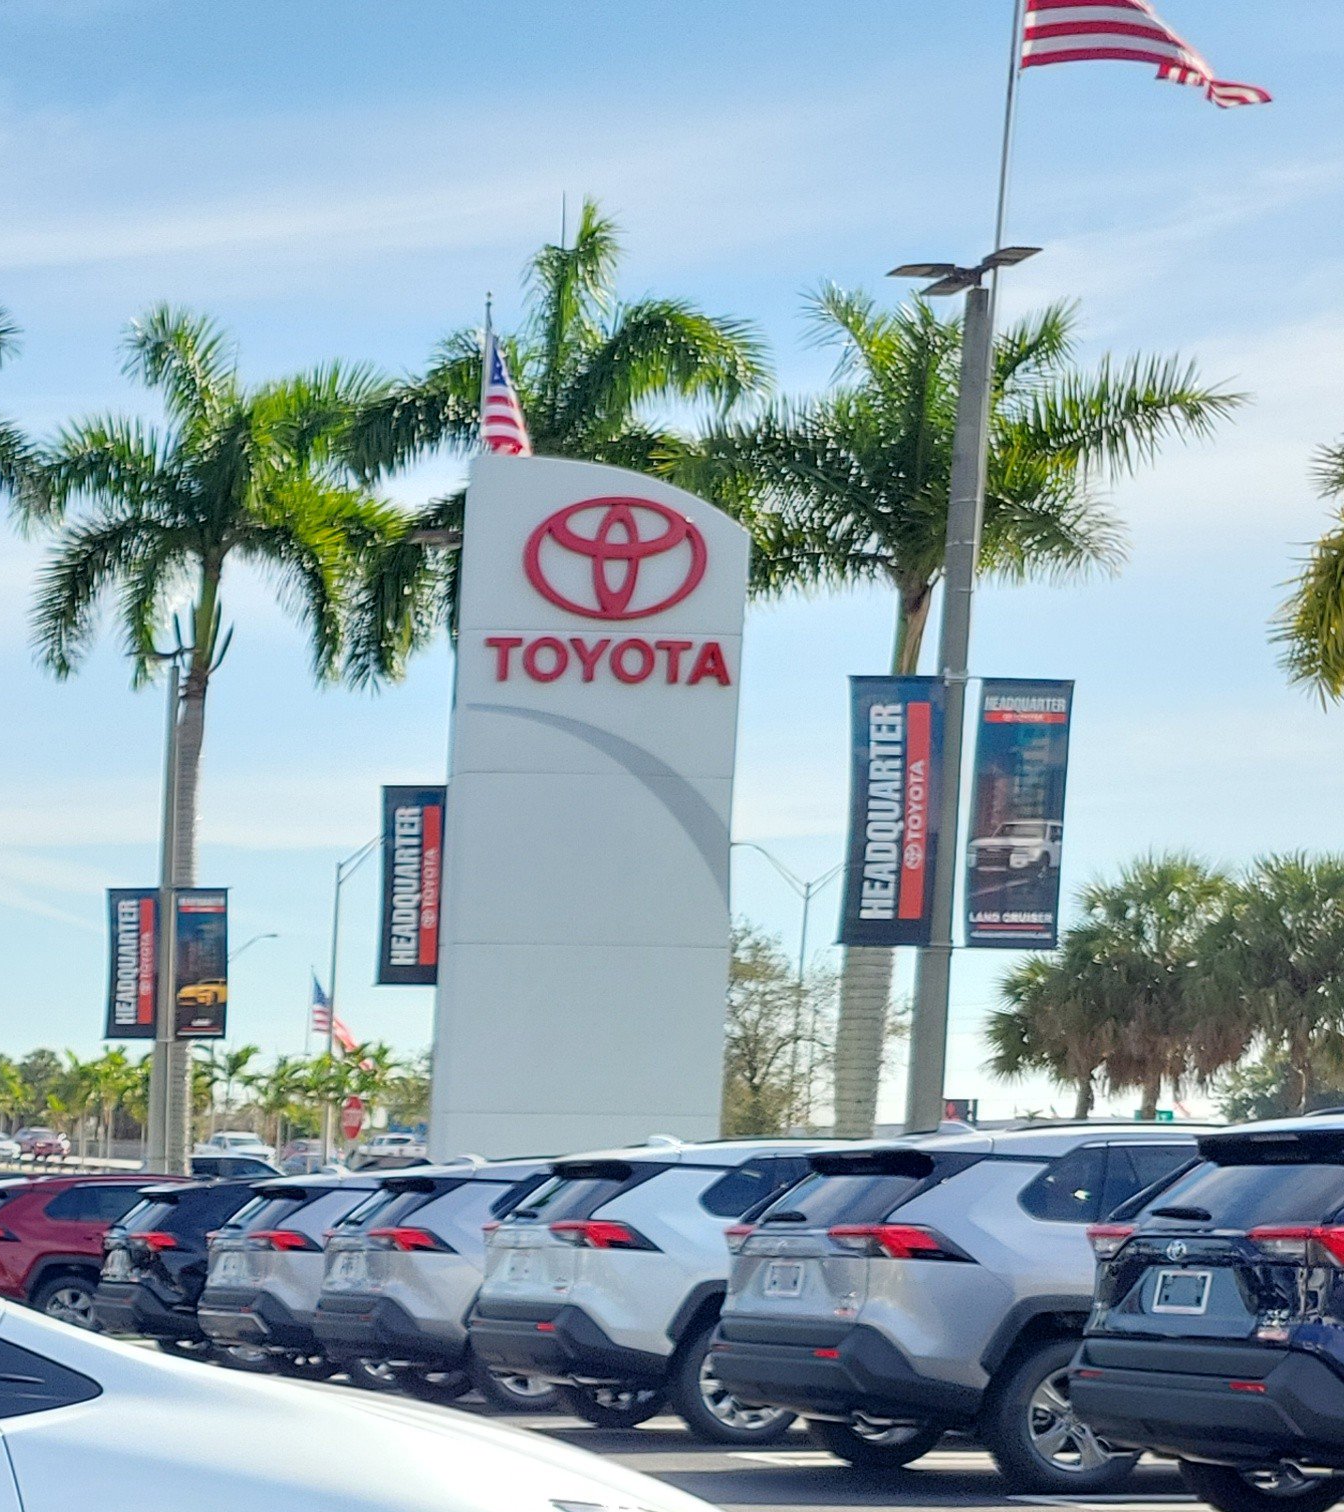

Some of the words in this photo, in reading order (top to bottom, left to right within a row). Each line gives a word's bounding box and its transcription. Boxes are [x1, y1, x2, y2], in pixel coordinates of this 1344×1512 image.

[485, 636, 731, 686] TOYOTA
[859, 703, 904, 920] HEADQUARTER
[906, 760, 925, 841] TOYOTA
[389, 805, 422, 966] HEADQUARTER
[422, 848, 438, 908] TOYOTA
[115, 900, 140, 1025] HEADQUARTER
